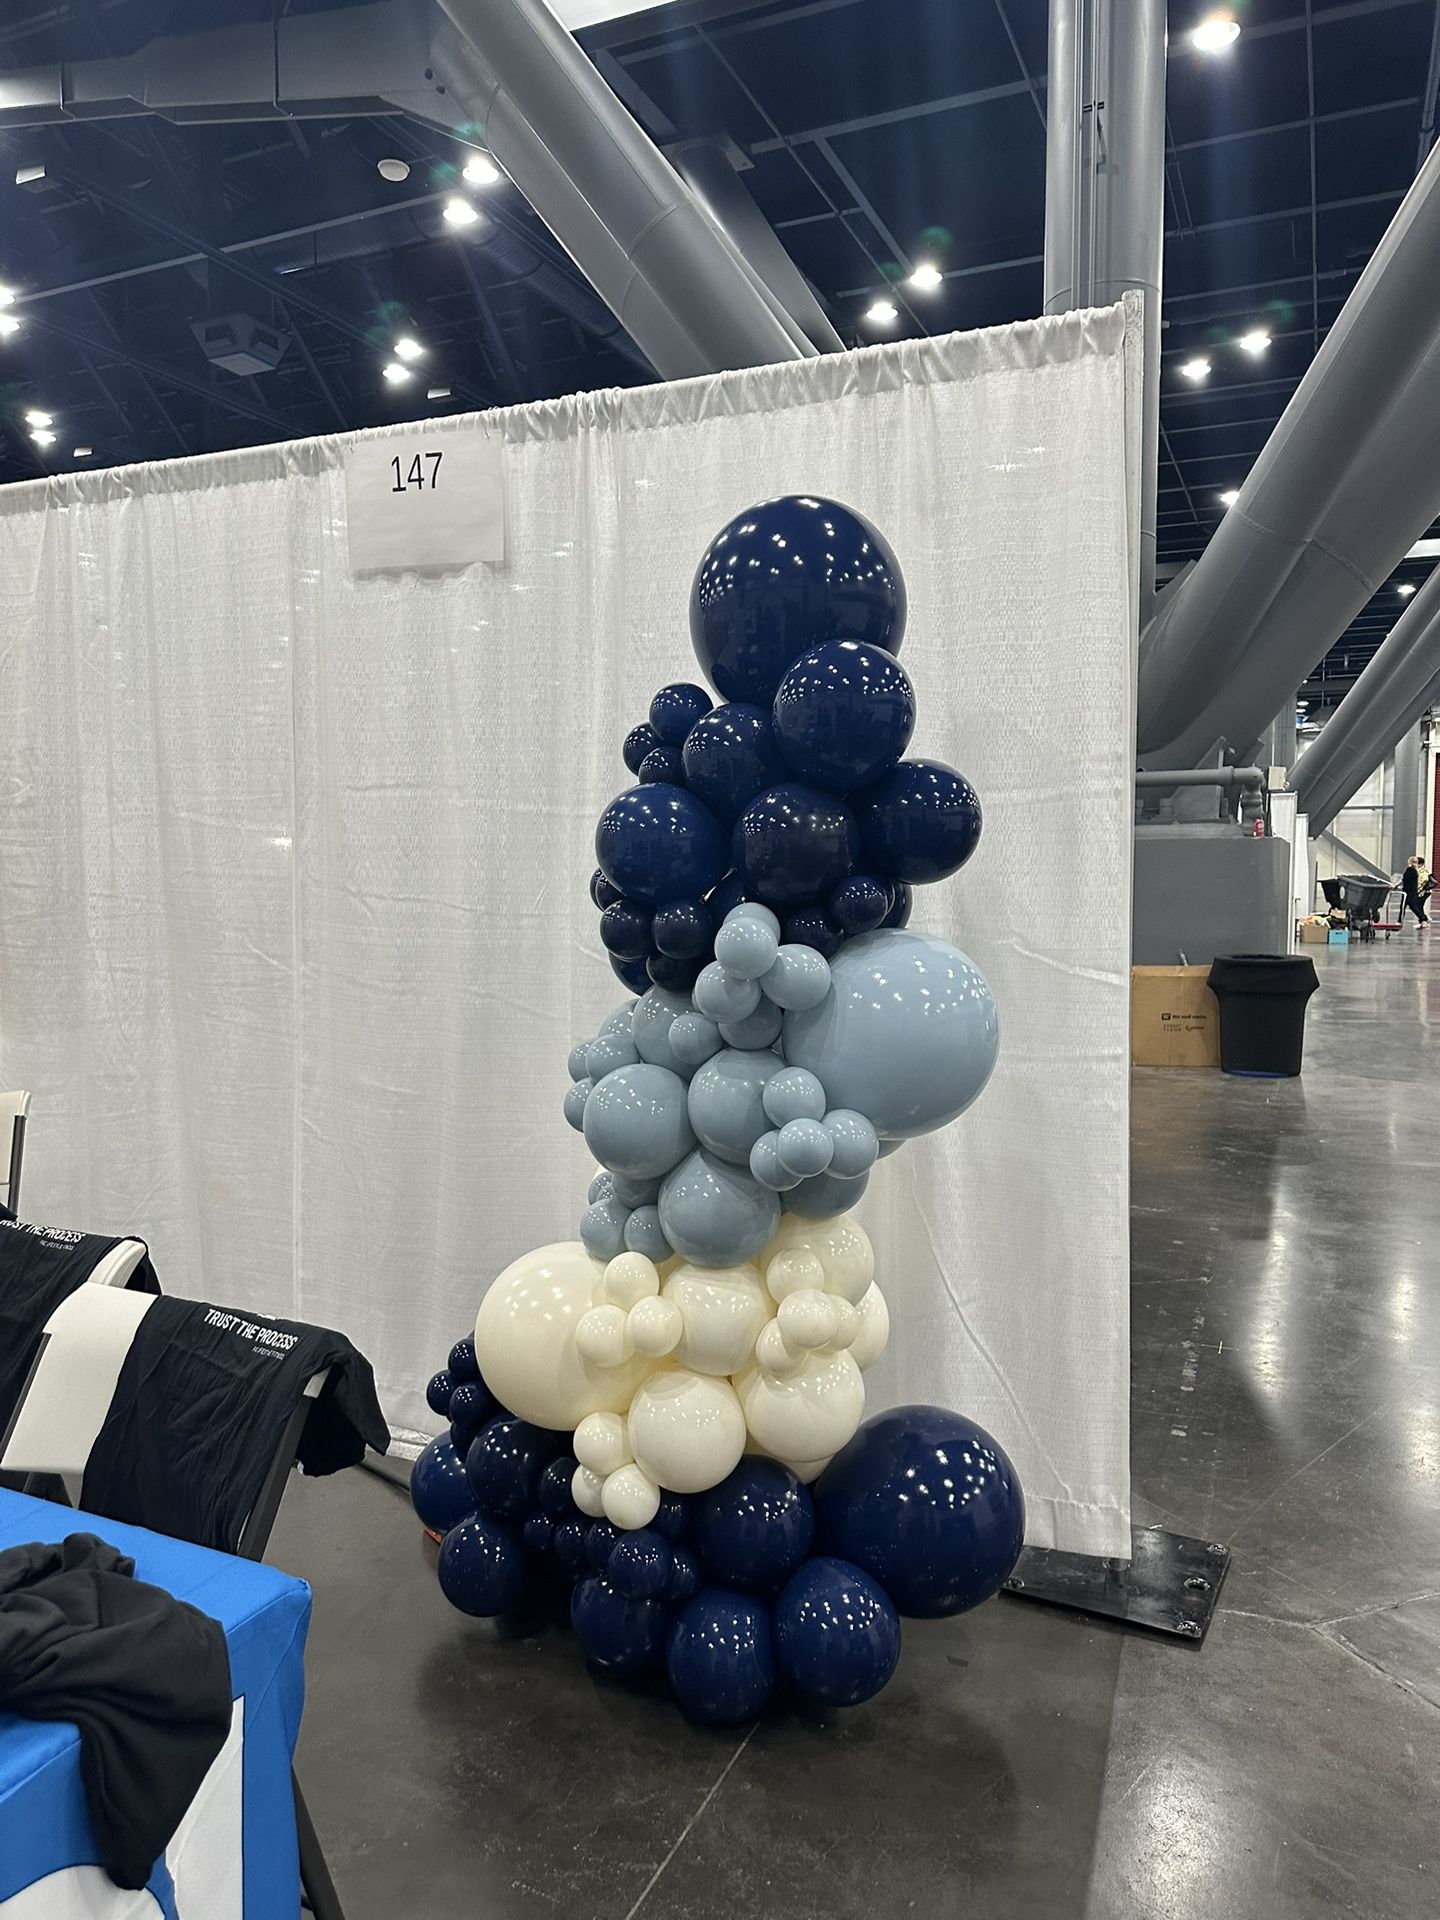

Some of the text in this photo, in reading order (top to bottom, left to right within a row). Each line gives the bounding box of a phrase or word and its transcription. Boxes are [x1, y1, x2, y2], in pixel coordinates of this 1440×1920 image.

[391, 452, 443, 492] 147
[204, 1308, 298, 1350] TRUST THE PROCESS
